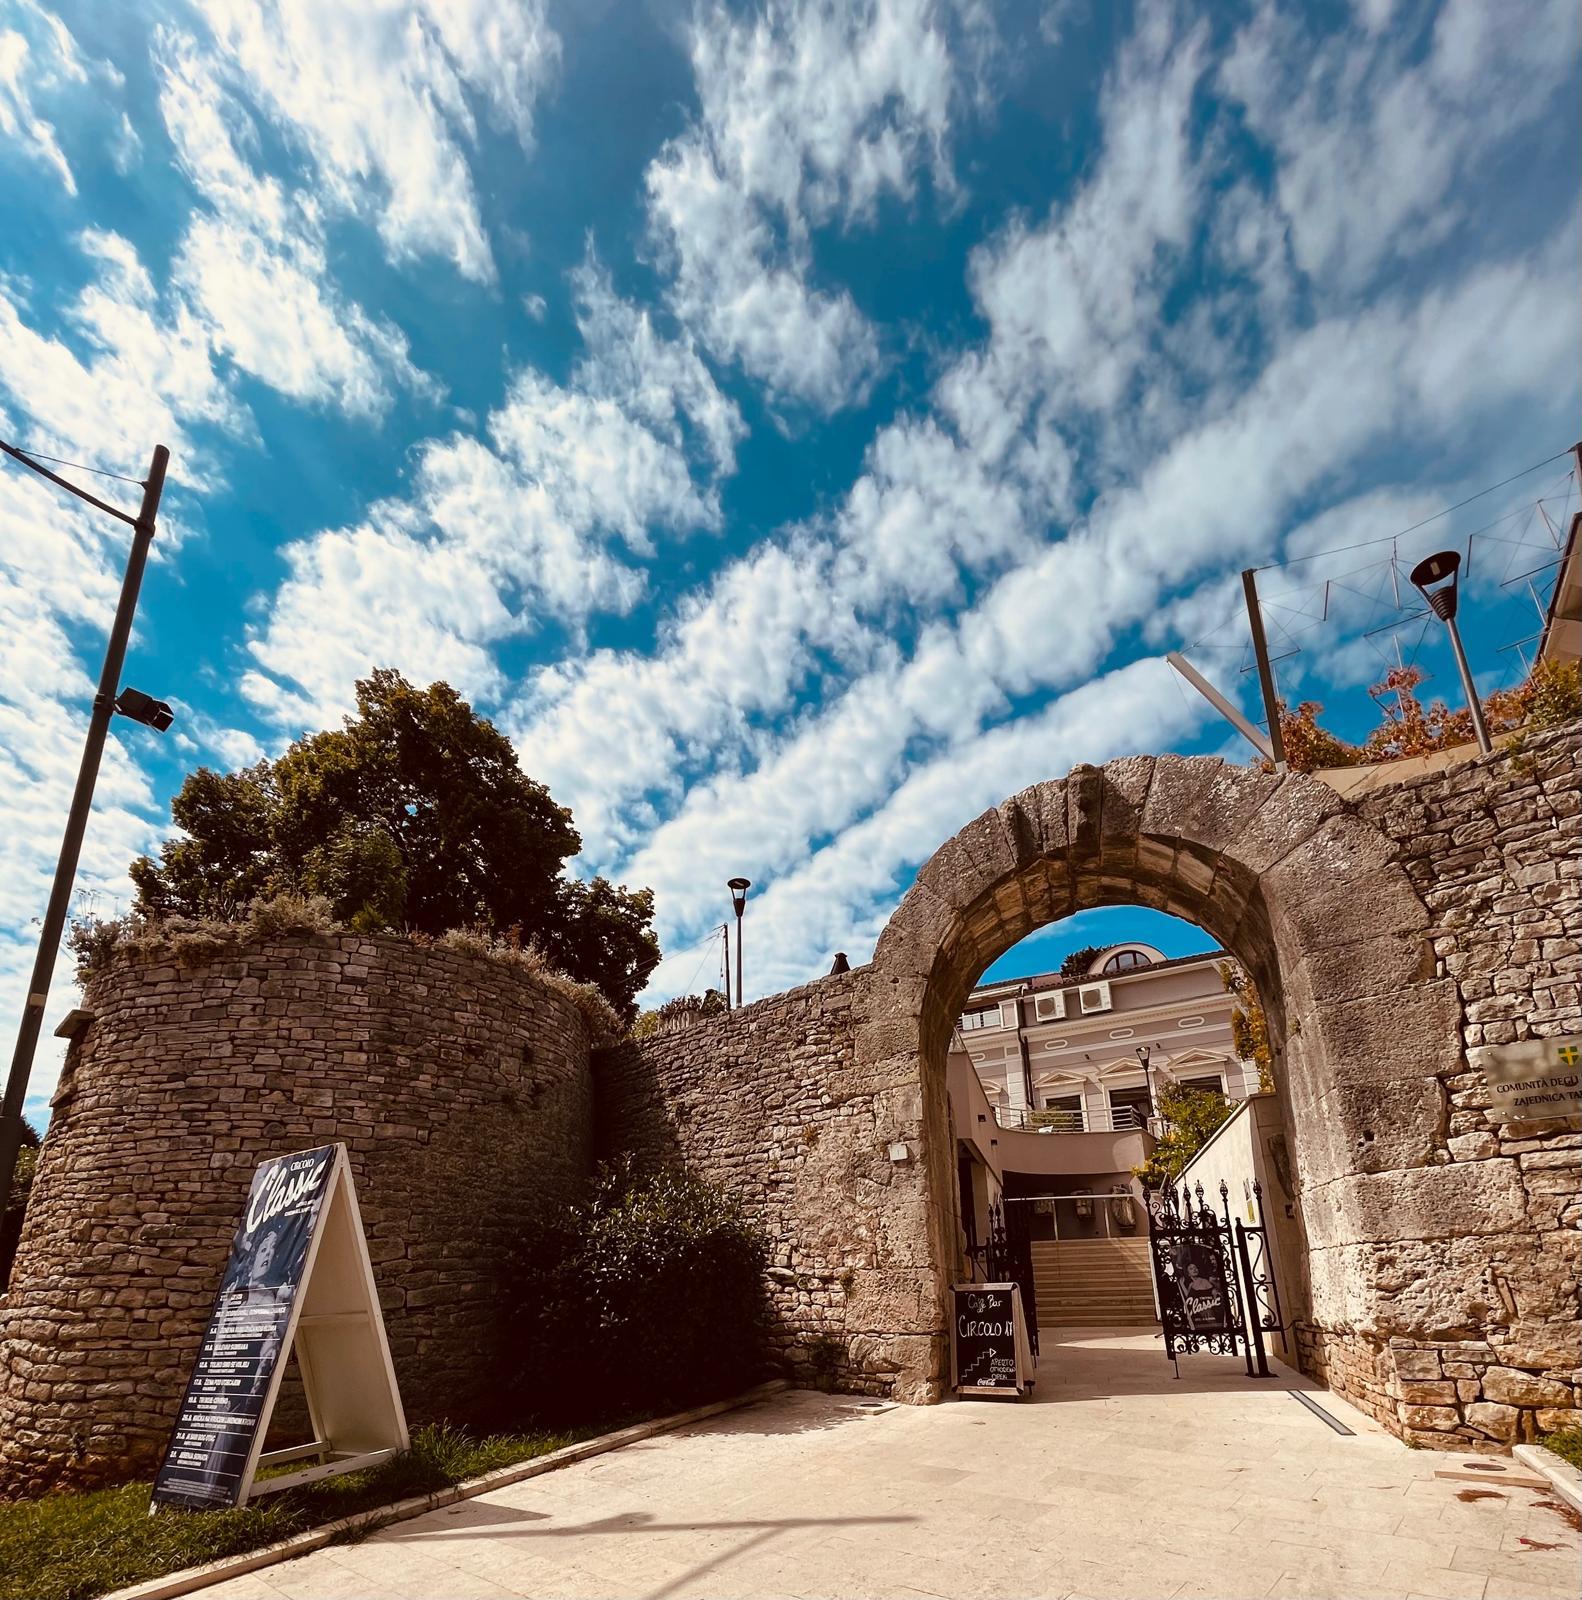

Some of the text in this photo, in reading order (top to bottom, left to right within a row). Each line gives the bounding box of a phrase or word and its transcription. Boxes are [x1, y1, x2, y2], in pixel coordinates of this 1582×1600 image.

[1496, 1077, 1549, 1094] COMUNITÀ
[1513, 1093, 1566, 1107] ZAJEDNICA
[246, 1159, 327, 1234] Classic
[987, 1294, 1003, 1309] Bar
[1184, 1296, 1221, 1316] Classic
[959, 1315, 1002, 1338] CIRCOLO
